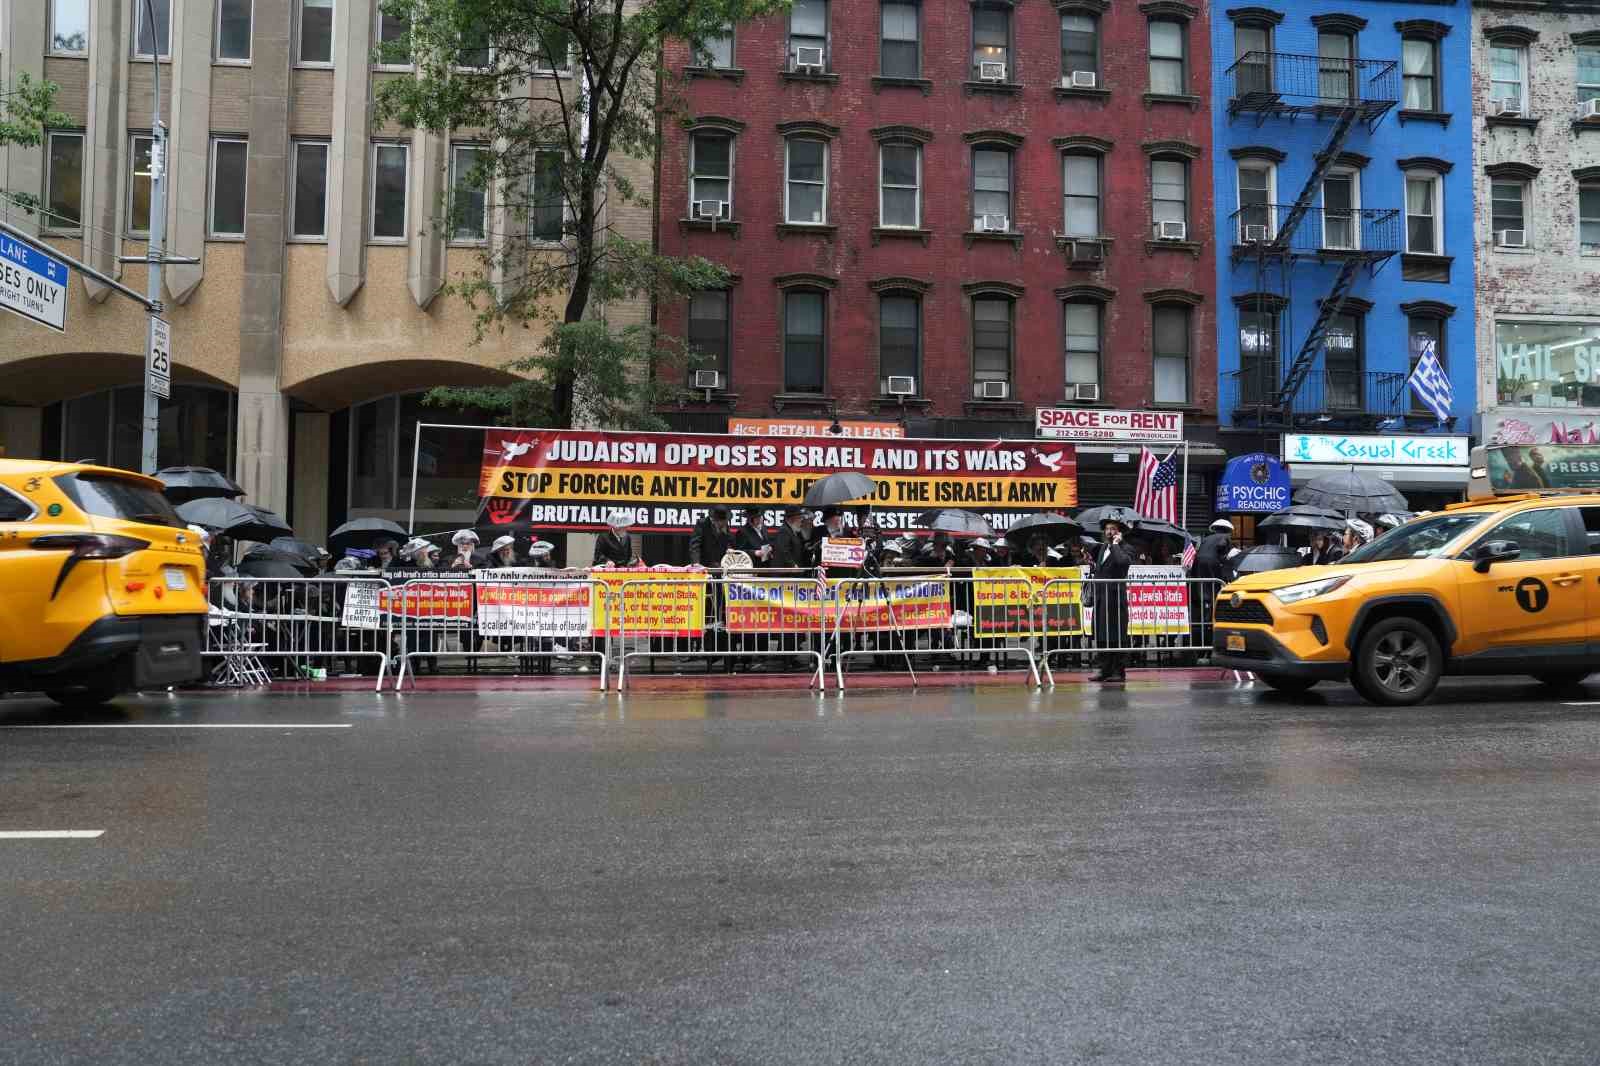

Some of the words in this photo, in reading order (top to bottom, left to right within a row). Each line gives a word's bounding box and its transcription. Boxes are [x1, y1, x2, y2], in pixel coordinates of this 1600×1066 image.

[1, 238, 28, 264] LANE
[26, 276, 58, 304] ONLY
[23, 295, 44, 313] TURNS
[153, 348, 168, 373] 25
[1496, 343, 1560, 383] NAIL
[1039, 410, 1100, 427] SPACE
[1103, 415, 1128, 425] FOR
[1130, 413, 1178, 430] RENT
[768, 424, 815, 437] RETAIL
[855, 427, 900, 439] LEASE
[545, 439, 657, 464] JUDAISM
[664, 443, 777, 467] OPPOSES
[784, 445, 866, 469] ISRAEL
[871, 448, 918, 471] AND
[924, 449, 960, 471] ITS
[963, 449, 1027, 472] WARS
[1334, 438, 1395, 459] Casual
[1400, 440, 1457, 459] Greek
[501, 470, 552, 494] STOP
[558, 472, 644, 497] FORCING
[650, 475, 786, 499] ANTI-ZIONIST
[896, 481, 930, 502] THE
[934, 481, 1002, 503] ISRAELI
[1008, 481, 1058, 503] ARMY
[1232, 485, 1286, 500] PSYCHIC
[1237, 500, 1282, 511] READINGS
[729, 583, 765, 601] State
[729, 611, 746, 624] Do
[750, 610, 778, 624] NOT
